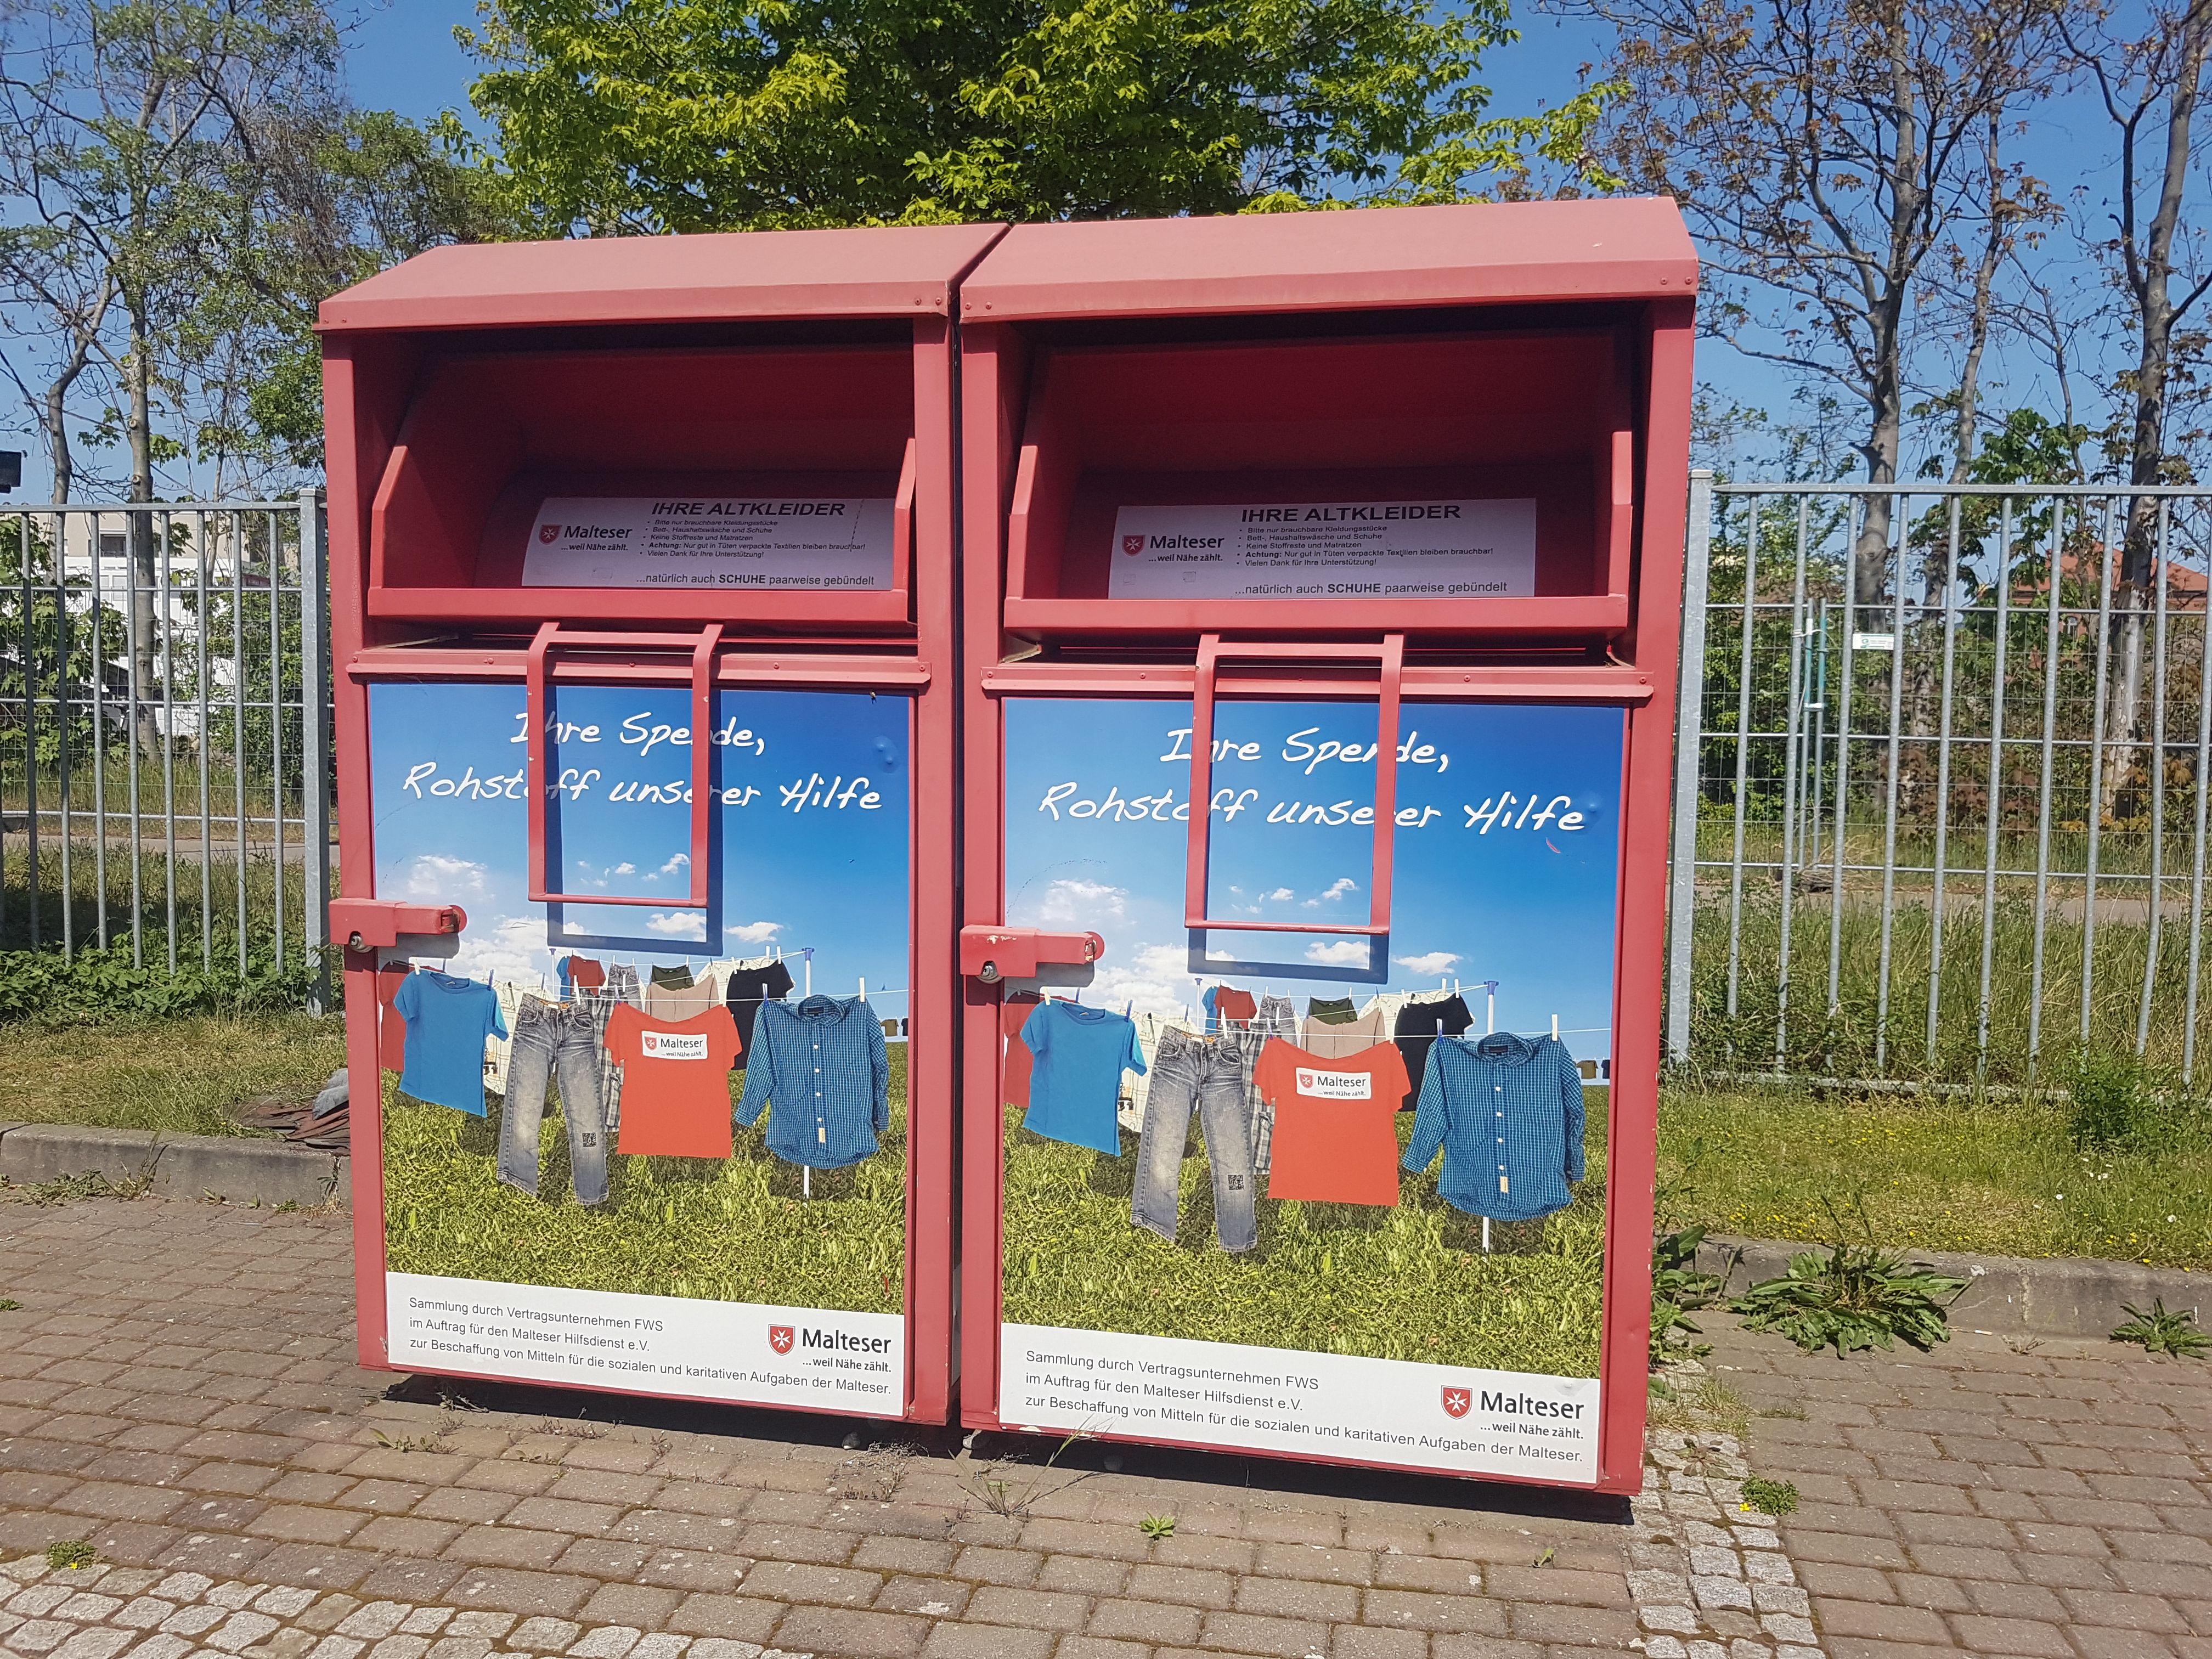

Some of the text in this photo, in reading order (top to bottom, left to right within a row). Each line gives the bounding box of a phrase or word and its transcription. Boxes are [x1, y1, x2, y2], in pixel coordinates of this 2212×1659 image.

[652, 503, 845, 515] IHRE ALTKLEIDER
[1242, 505, 1461, 522] IHRE ALTKLEIDER
[564, 525, 633, 538] Malteser
[1150, 535, 1224, 549] Malteser
[636, 574, 874, 586] ...natürlich auch SCHUHE paarweise gebündelt
[1235, 582, 1507, 595] ...natürlich auch SCHUHE paarweise gebündelt
[620, 712, 765, 757] Spede,
[780, 773, 882, 813] Hilfe
[1267, 800, 1442, 828] unseer
[1464, 791, 1585, 834] Hilfe
[661, 1039, 703, 1048] Malteser
[1317, 1076, 1366, 1087] Malteser
[409, 1297, 664, 1332] Sammlung durch Vertragsunternehmen FWS
[409, 1318, 651, 1352] im Auftrag für den Malteser Hilfsdienst e.V.
[802, 1328, 891, 1354] Malteser
[410, 1338, 891, 1395] zur Beschaffung von Mitteln für die sozialen und karitativen Aufgaben der Malteser.
[836, 1358, 862, 1370] Nähe
[864, 1361, 892, 1373] zählt.
[1026, 1351, 1318, 1390] Sammlung durch Vertragsunternehmen FWS
[1026, 1373, 1303, 1411] im Auftrag für den Malteser Hilfsdienst e.V.
[1480, 1391, 1585, 1420] Malteser
[1025, 1396, 1583, 1462] zur Beschaffung von Mitteln für die sozialen und karitativen Aufgaben der Malteser.
[1519, 1424, 1549, 1437] Nähe
[1553, 1427, 1584, 1440] zählt.
